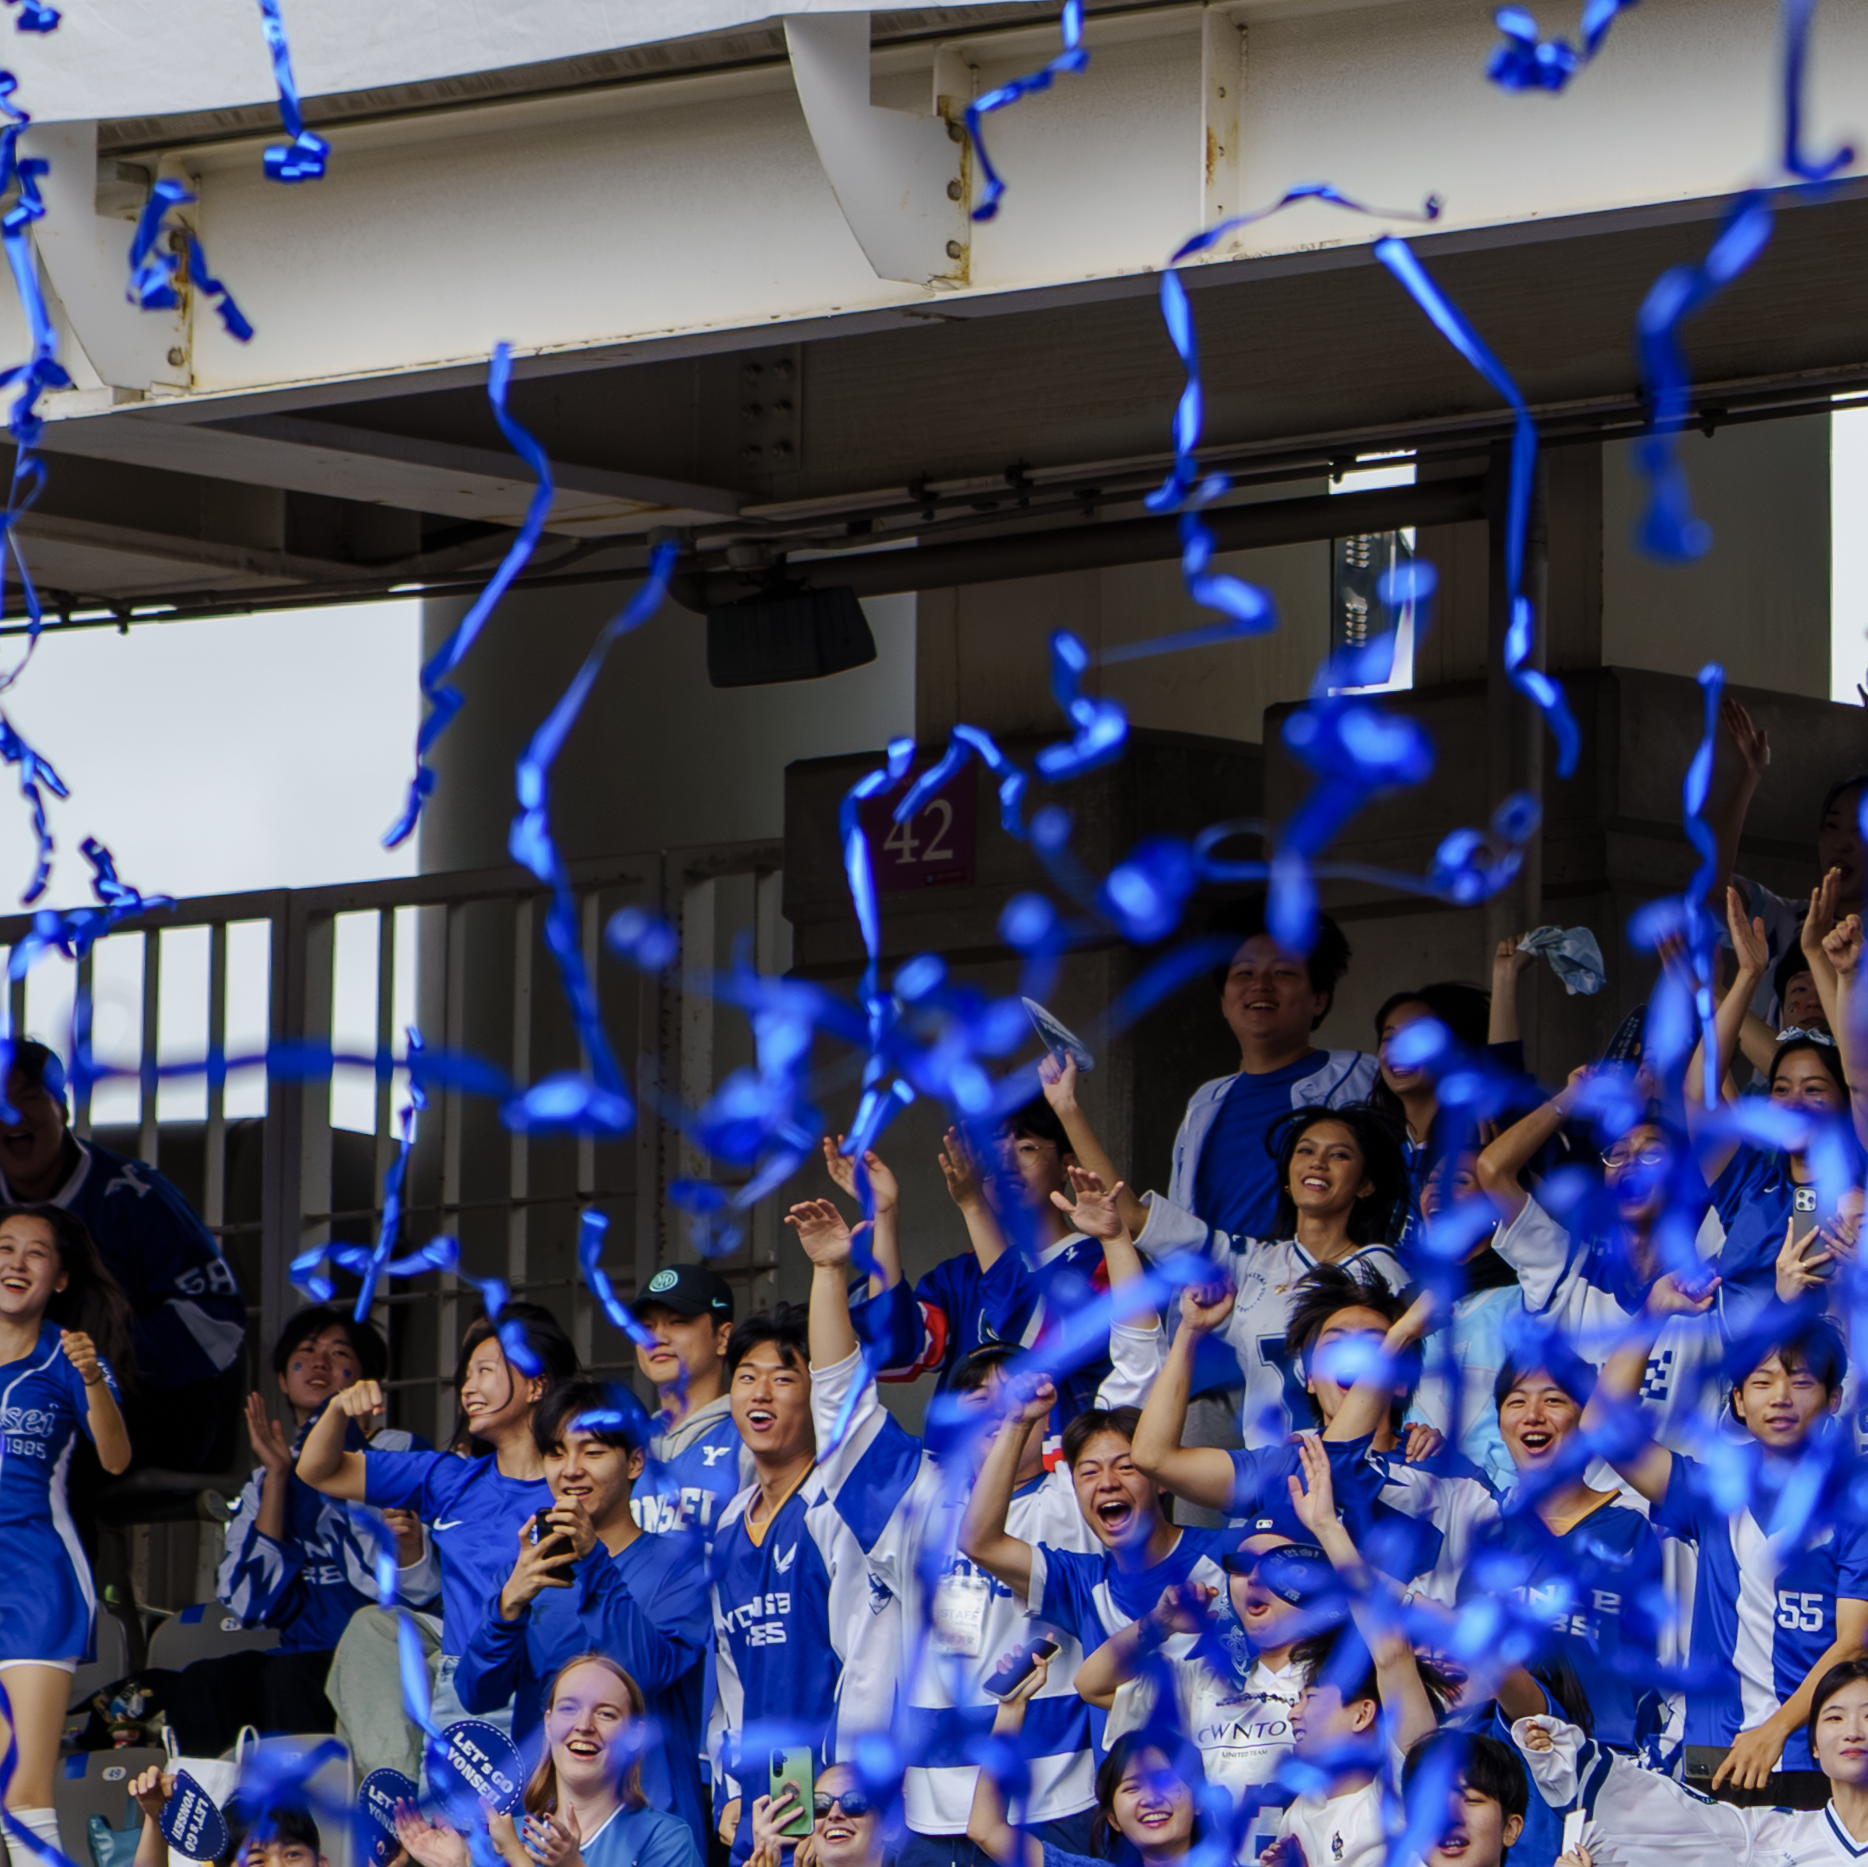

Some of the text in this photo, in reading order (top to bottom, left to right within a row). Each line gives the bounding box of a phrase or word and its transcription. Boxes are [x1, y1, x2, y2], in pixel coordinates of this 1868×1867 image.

[883, 798, 953, 864] 42
[5, 1436, 46, 1459] 1985
[1778, 1590, 1823, 1632] 55
[490, 1769, 514, 1794] GO
[186, 1830, 200, 1853] GO
